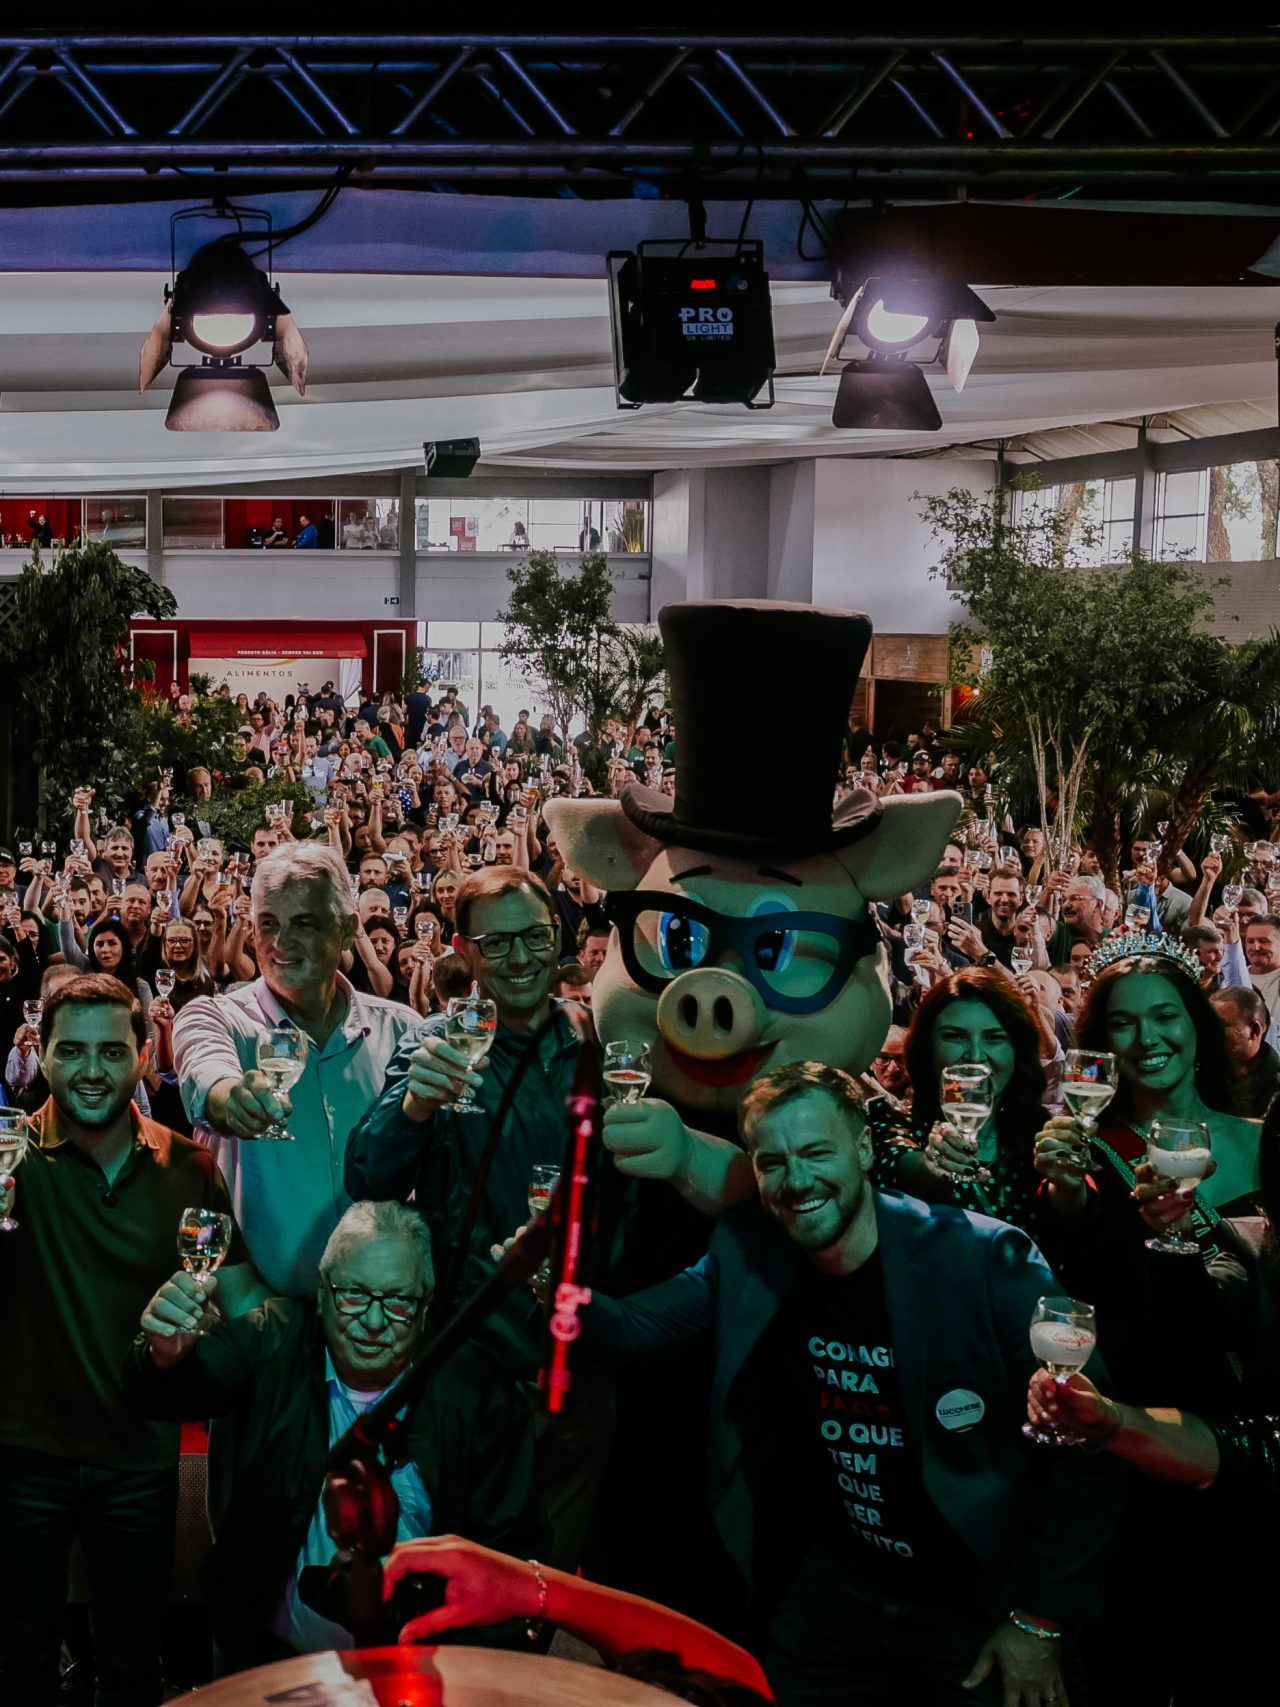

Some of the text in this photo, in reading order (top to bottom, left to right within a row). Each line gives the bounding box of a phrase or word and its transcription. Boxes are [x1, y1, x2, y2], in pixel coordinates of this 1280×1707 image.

[678, 307, 734, 322] PRO
[686, 324, 731, 334] LIGHT
[226, 670, 293, 678] ALIMENTOS
[813, 1365, 880, 1394] PARA
[821, 1420, 905, 1447] O QUE
[826, 1446, 877, 1475] TEM
[837, 1472, 885, 1503] QUE
[842, 1500, 884, 1527] SER
